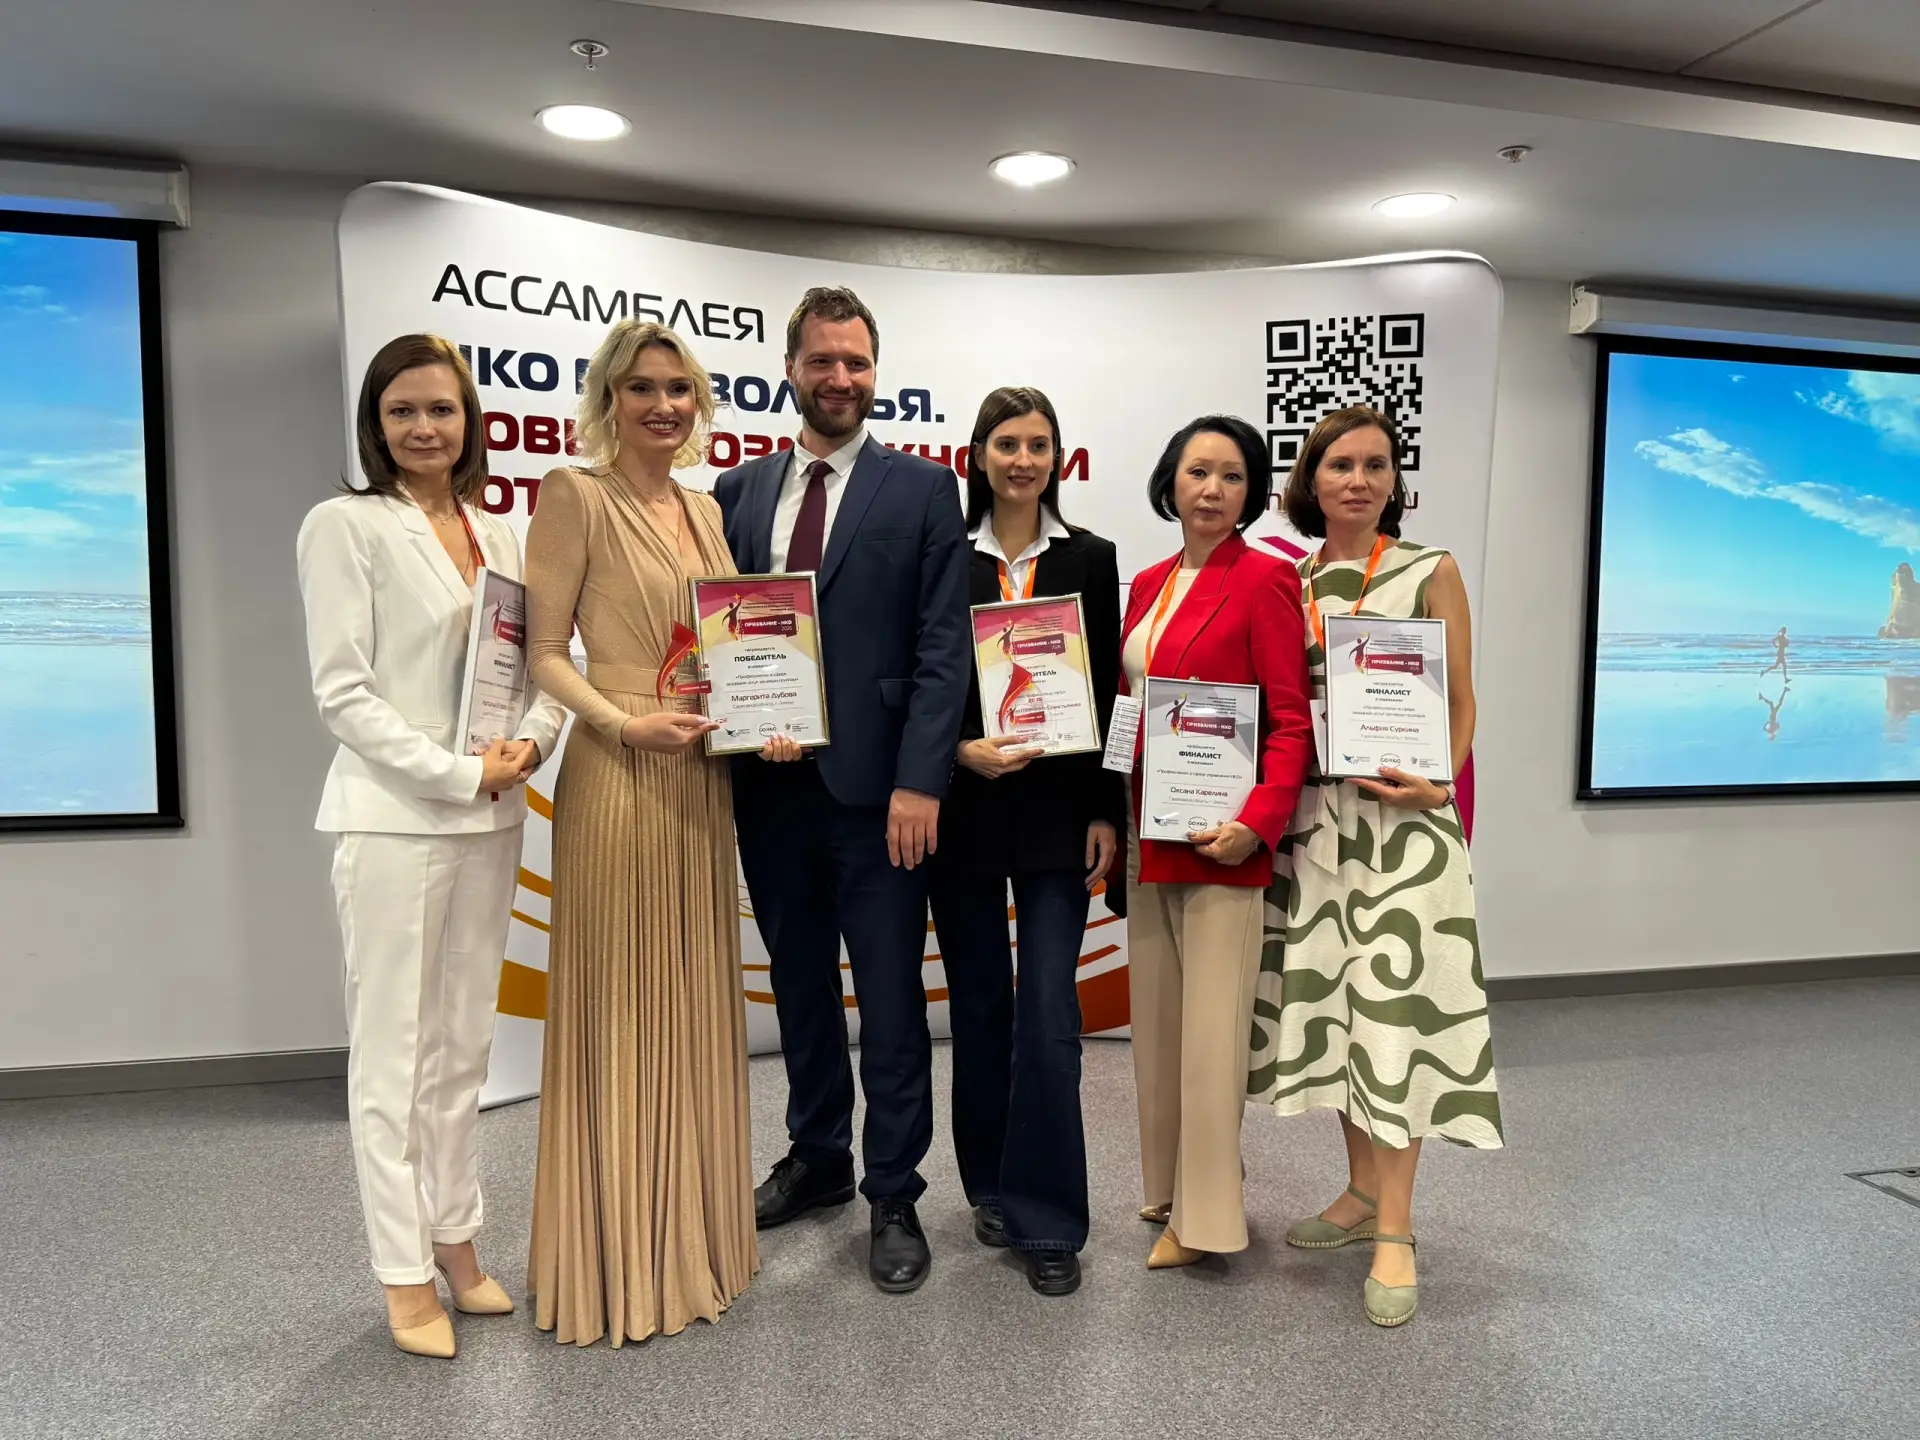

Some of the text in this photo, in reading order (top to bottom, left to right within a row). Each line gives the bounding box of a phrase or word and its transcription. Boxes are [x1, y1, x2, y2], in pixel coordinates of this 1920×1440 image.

[432, 264, 765, 343] АССАМБЛЕЯ
[733, 652, 786, 663] ПОБЕДИТЕЛЬ
[730, 690, 797, 702] Маргарита Дубова
[1365, 686, 1411, 696] ФИНАЛИСТ
[1178, 750, 1221, 759] ФИНАЛИСТ
[1170, 786, 1228, 797] Оксана Карелина
